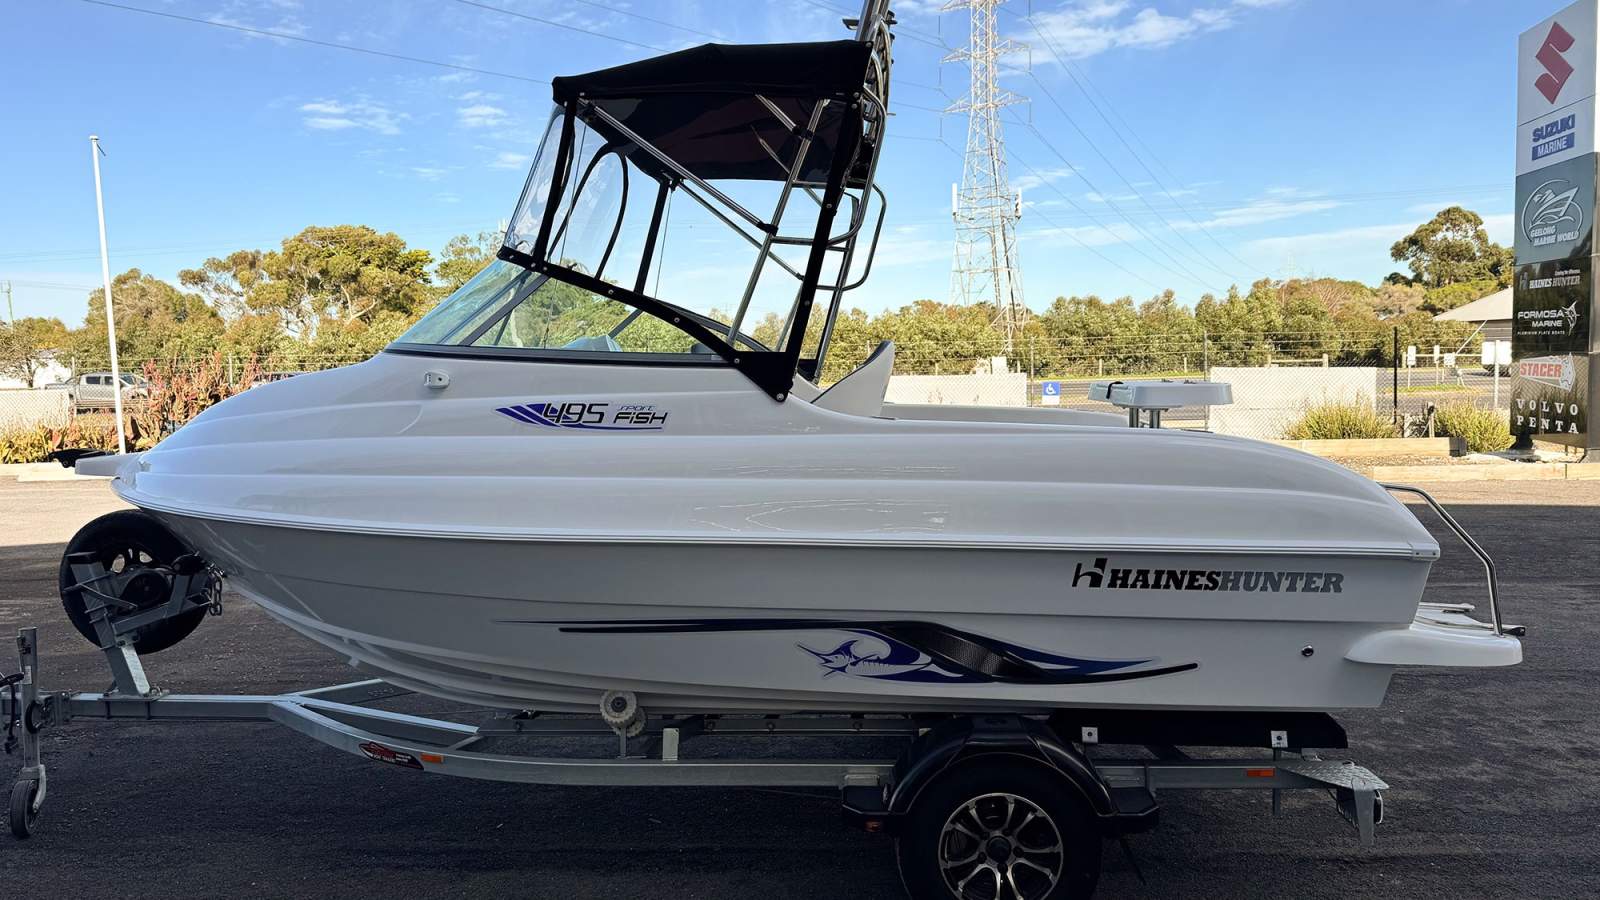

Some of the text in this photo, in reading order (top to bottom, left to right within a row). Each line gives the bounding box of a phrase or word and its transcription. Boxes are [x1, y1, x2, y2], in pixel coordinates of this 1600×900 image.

[1532, 113, 1576, 143] SUZUKI
[1537, 140, 1568, 157] MARINE
[1530, 225, 1556, 238] GEELONG
[1533, 231, 1579, 247] MARINE WORLD
[1517, 309, 1565, 319] FORMOSA
[1531, 320, 1562, 328] MARINE
[1520, 362, 1562, 378] STACER
[543, 403, 608, 424] 495
[1516, 398, 1578, 416] VOLVO
[1516, 415, 1579, 434] PENTA
